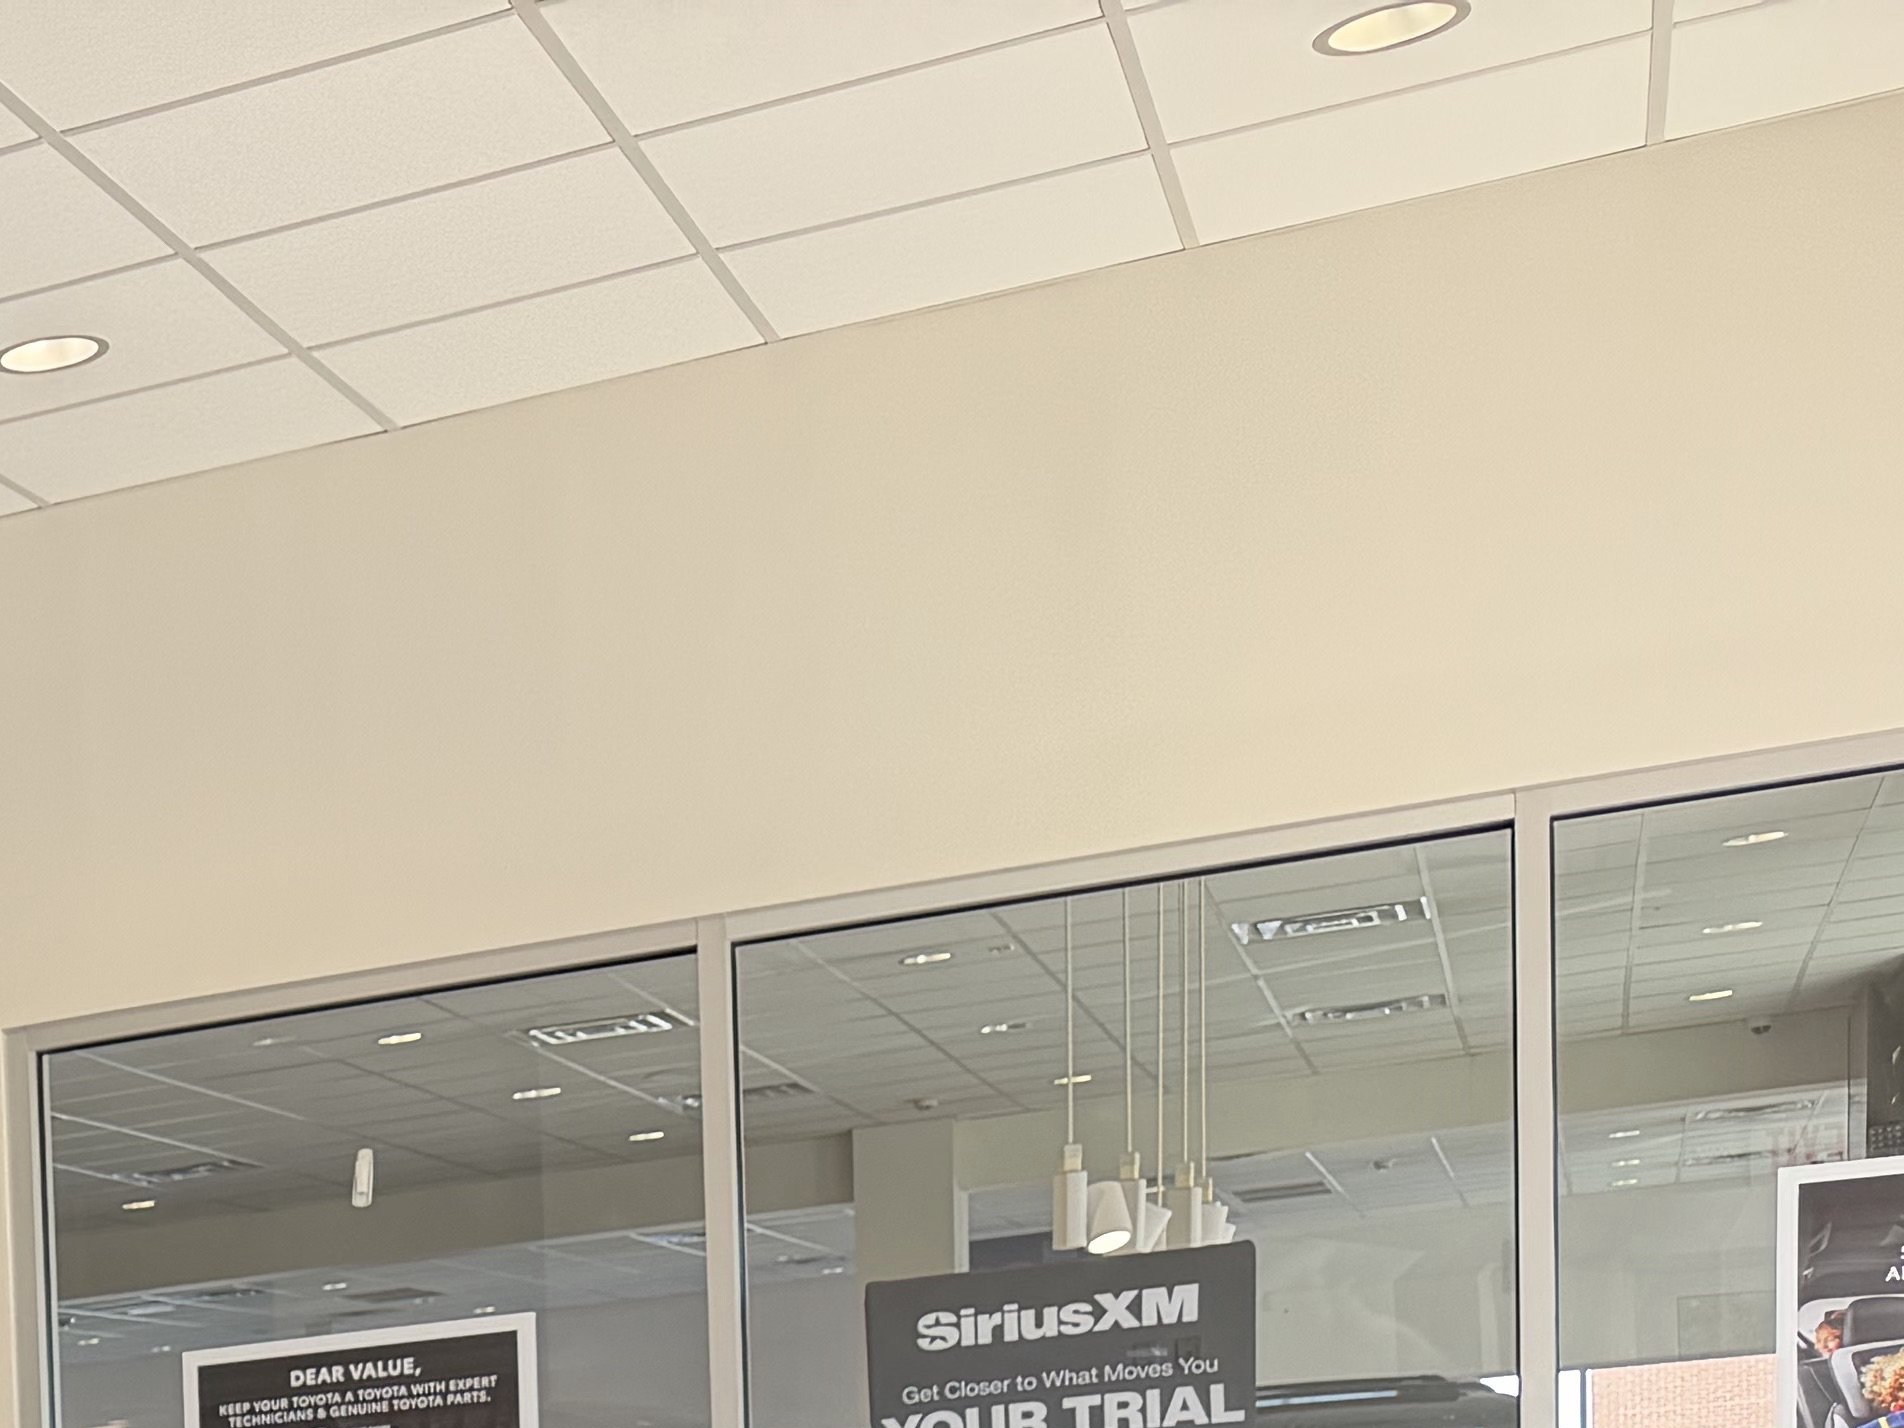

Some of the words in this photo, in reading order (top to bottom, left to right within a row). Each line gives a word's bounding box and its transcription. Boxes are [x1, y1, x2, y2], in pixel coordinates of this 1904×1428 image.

[916, 1282, 1200, 1351] SiriusXM
[290, 1364, 345, 1387] DEAR
[349, 1356, 422, 1382] VALUE,
[902, 1384, 939, 1405] Get
[944, 1378, 1010, 1401] Closer
[1016, 1375, 1038, 1391] to
[1043, 1366, 1099, 1389] What
[1103, 1361, 1174, 1383] Moves
[1178, 1357, 1219, 1376] You
[219, 1402, 251, 1417] KEEP
[253, 1399, 289, 1414] YOUR
[292, 1393, 342, 1409] TOYOTA
[345, 1392, 354, 1403] A
[357, 1386, 408, 1401] TOYOTA
[410, 1380, 446, 1395] WITH
[449, 1375, 498, 1391] EXPERT
[228, 1406, 314, 1428] TECHNICIANS
[316, 1407, 327, 1419] &
[329, 1400, 390, 1417] GENUINE
[392, 1395, 443, 1412] TOYOTA
[446, 1390, 492, 1405] PARTS.
